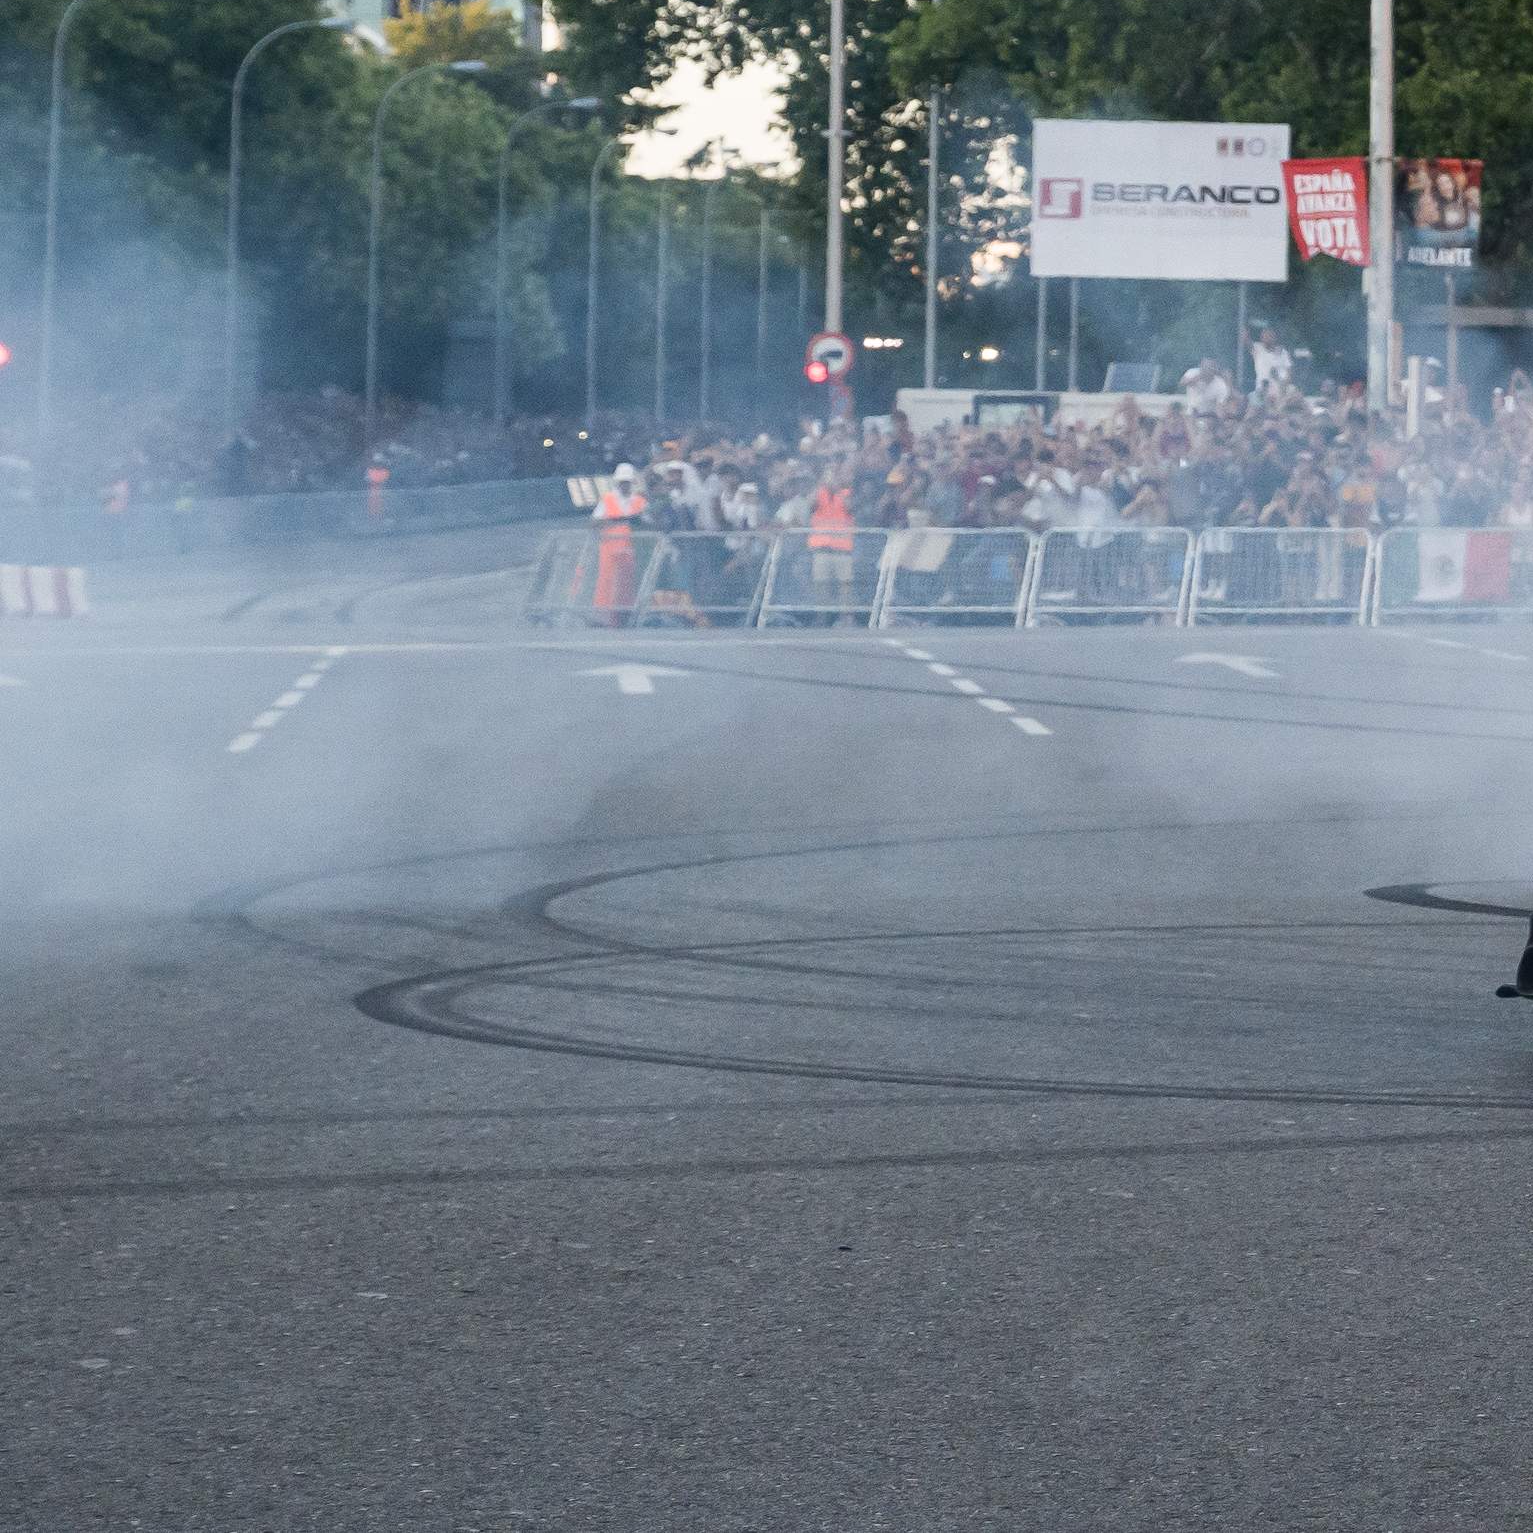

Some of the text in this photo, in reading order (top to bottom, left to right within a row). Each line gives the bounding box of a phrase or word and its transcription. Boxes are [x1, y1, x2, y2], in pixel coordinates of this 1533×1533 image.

[1293, 168, 1356, 195] ESPAÑA
[1296, 193, 1357, 214] AVANZA
[1300, 217, 1362, 249] VOTA
